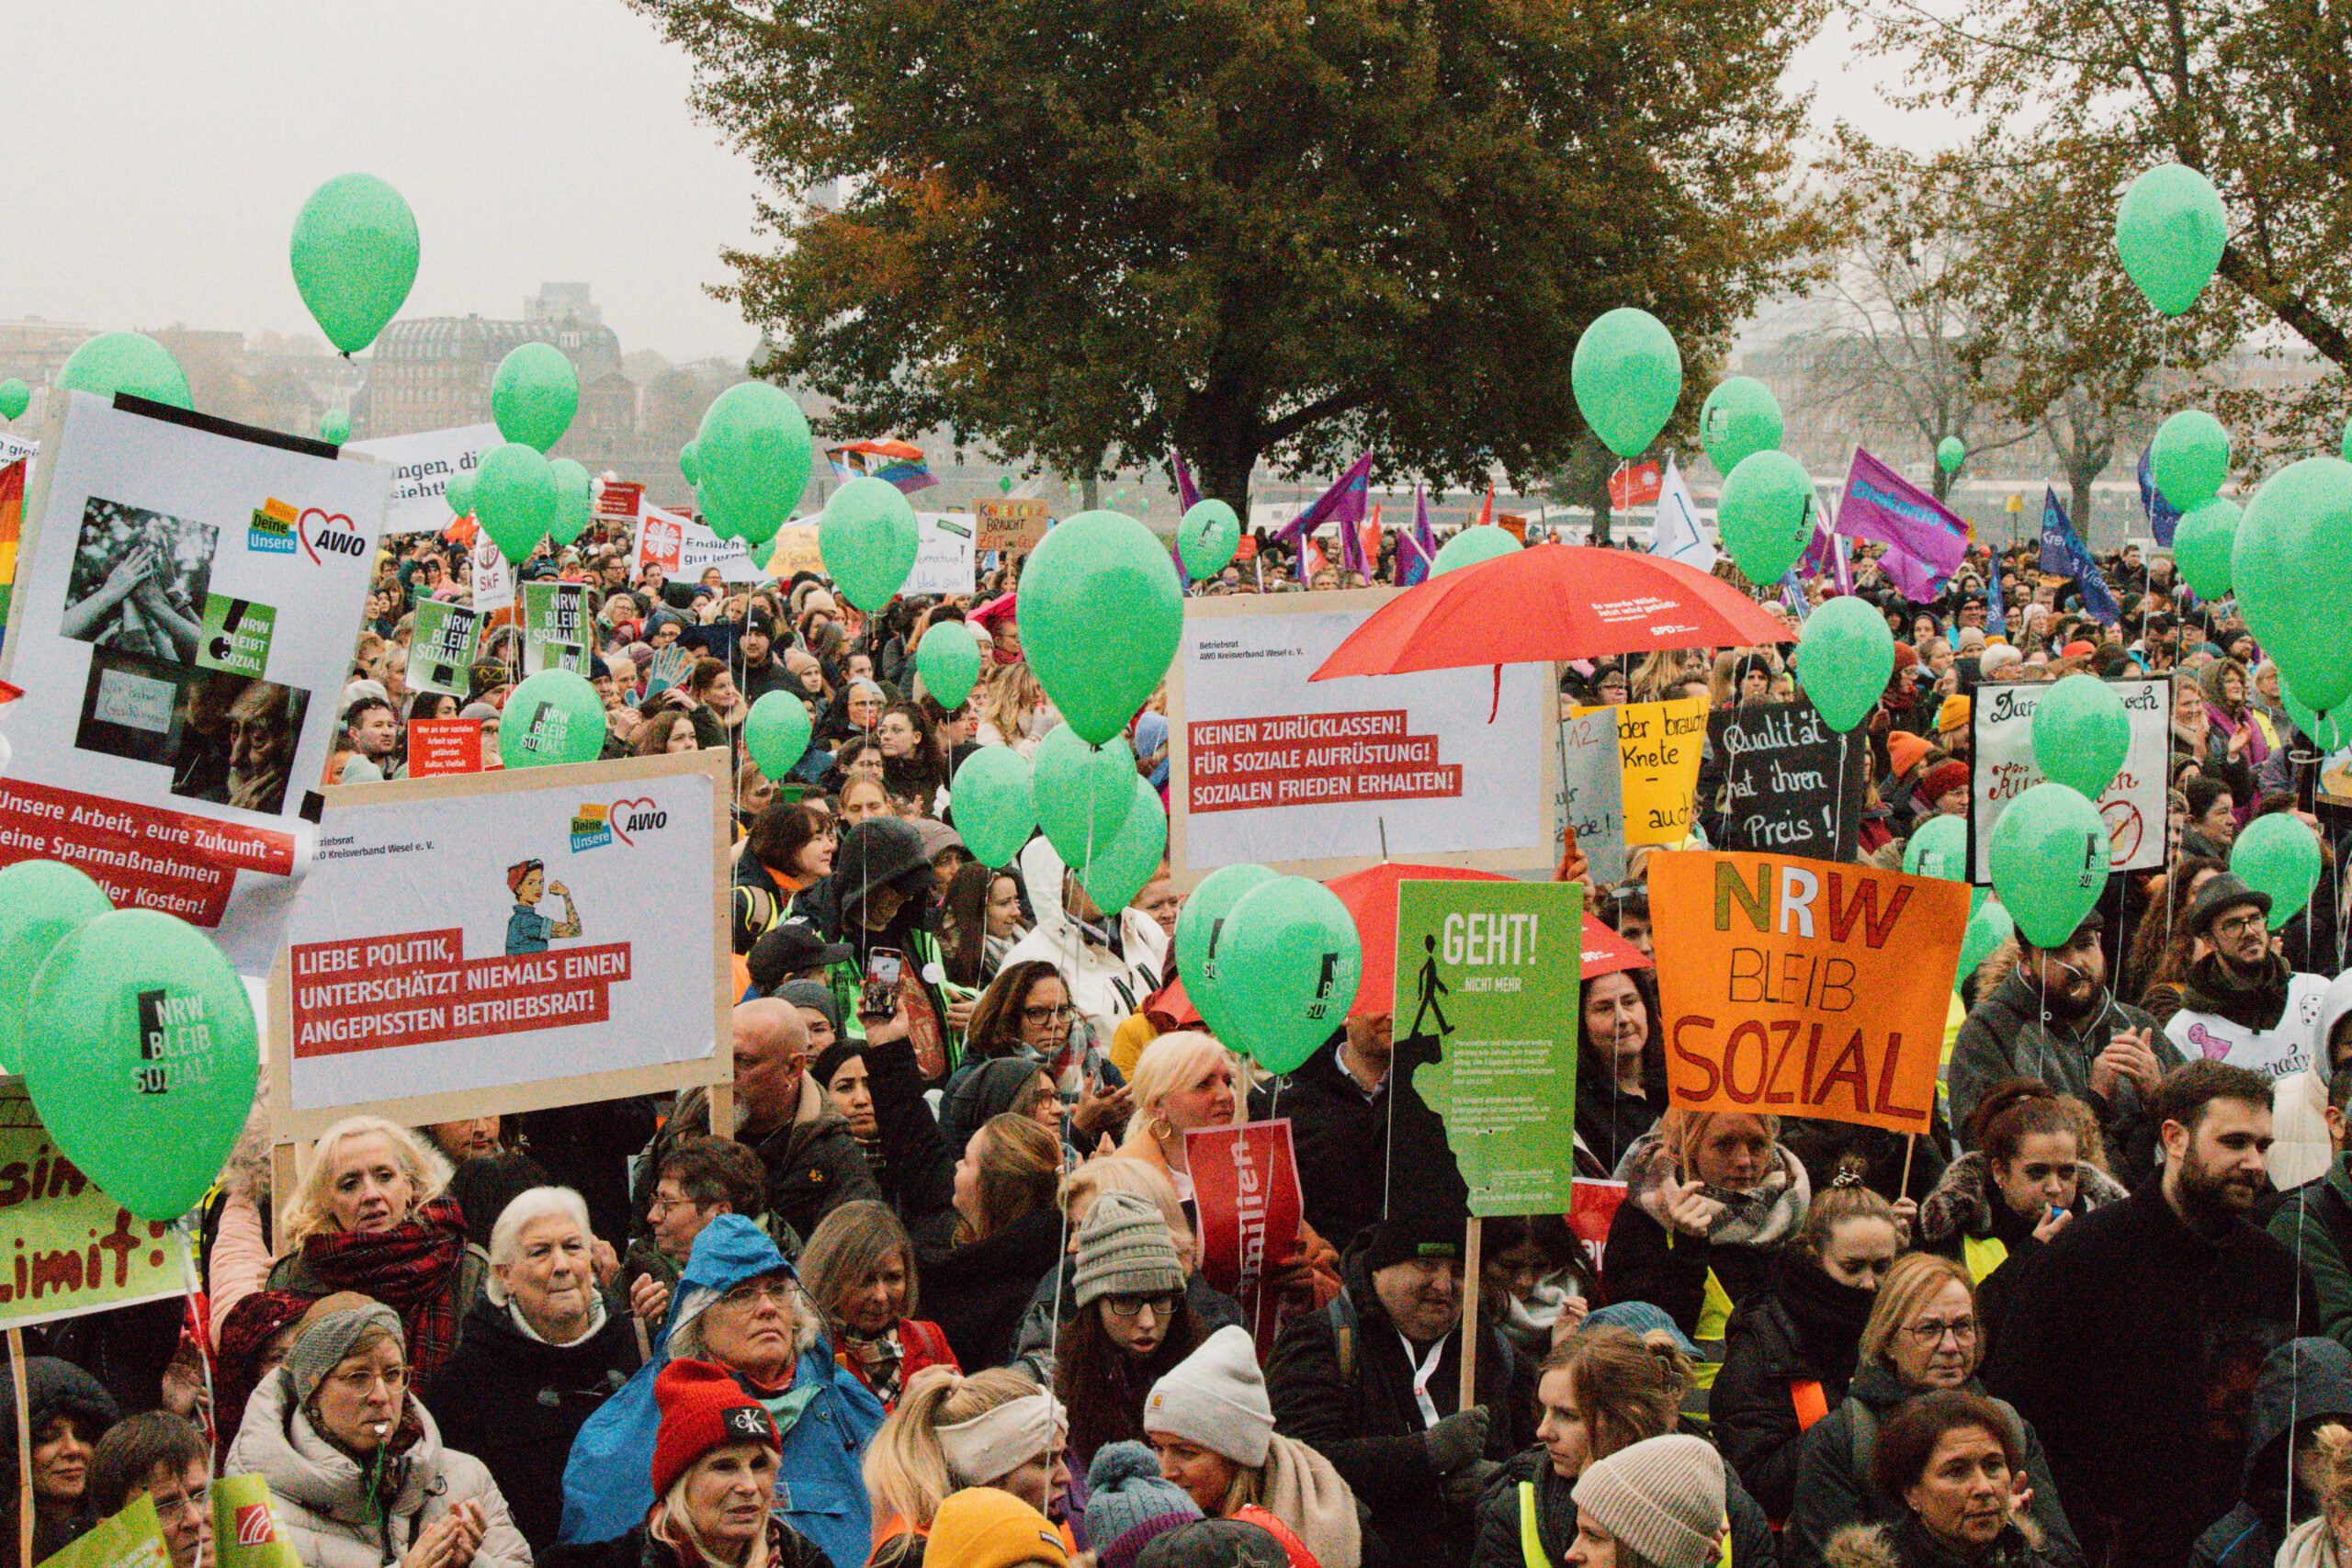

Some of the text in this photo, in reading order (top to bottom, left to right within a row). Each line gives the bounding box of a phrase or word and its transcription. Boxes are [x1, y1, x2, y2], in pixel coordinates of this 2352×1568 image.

[253, 513, 288, 534] Deine
[250, 533, 295, 550] Unsere
[314, 528, 367, 558] AWO
[550, 593, 582, 611] NRW
[238, 616, 270, 634] NRW
[440, 613, 475, 634] NRW
[545, 611, 582, 628] BLEIB
[1650, 625, 1676, 636] SPD
[222, 632, 268, 652] BLEIBT
[431, 628, 470, 650] BLEIB
[1199, 639, 1239, 650] Betriebsrat
[220, 650, 262, 671] SOZIAL
[414, 643, 469, 668] SOZIAL!
[1199, 651, 1216, 661] AWO
[1217, 649, 1265, 660] Kreisverband
[1266, 648, 1287, 658] Wesel
[1193, 716, 1402, 747] KEINEN ZURÜCKLASSEN!
[1723, 708, 1828, 756] Qualität
[1193, 741, 1430, 776] FÜR SOZIALE AUFRÜSTUNG!
[1622, 739, 1679, 769] Knete
[1193, 770, 1454, 807] SOZIALEN FRIEDEN ERHALTEN!
[1770, 759, 1828, 794] ihren
[70, 805, 139, 838] Arbeit,
[146, 822, 190, 844] eure
[194, 829, 267, 859] Zukunft
[626, 811, 667, 832] AWO
[328, 844, 386, 860] Kreisverband
[388, 841, 413, 853] Wesel
[571, 832, 610, 850] Unsere
[50, 836, 220, 885] Sparmaßnahmen
[134, 886, 207, 915] Kosten!
[1714, 861, 1915, 950] NRW
[1442, 912, 1540, 966] GEHT!
[300, 937, 455, 975] LIEBE POLITIK,
[300, 952, 626, 1010] UNTERSCHÄTZT NIEMALS EINEN
[1495, 976, 1522, 993] MEHR
[1728, 946, 1857, 1012] BLEIB
[154, 993, 203, 1027] NRW
[300, 988, 595, 1045] ANGEPISSTEN BETRIEBSRAT!
[149, 1023, 211, 1061] BLEIB
[1672, 1014, 1927, 1121] SOZIAL
